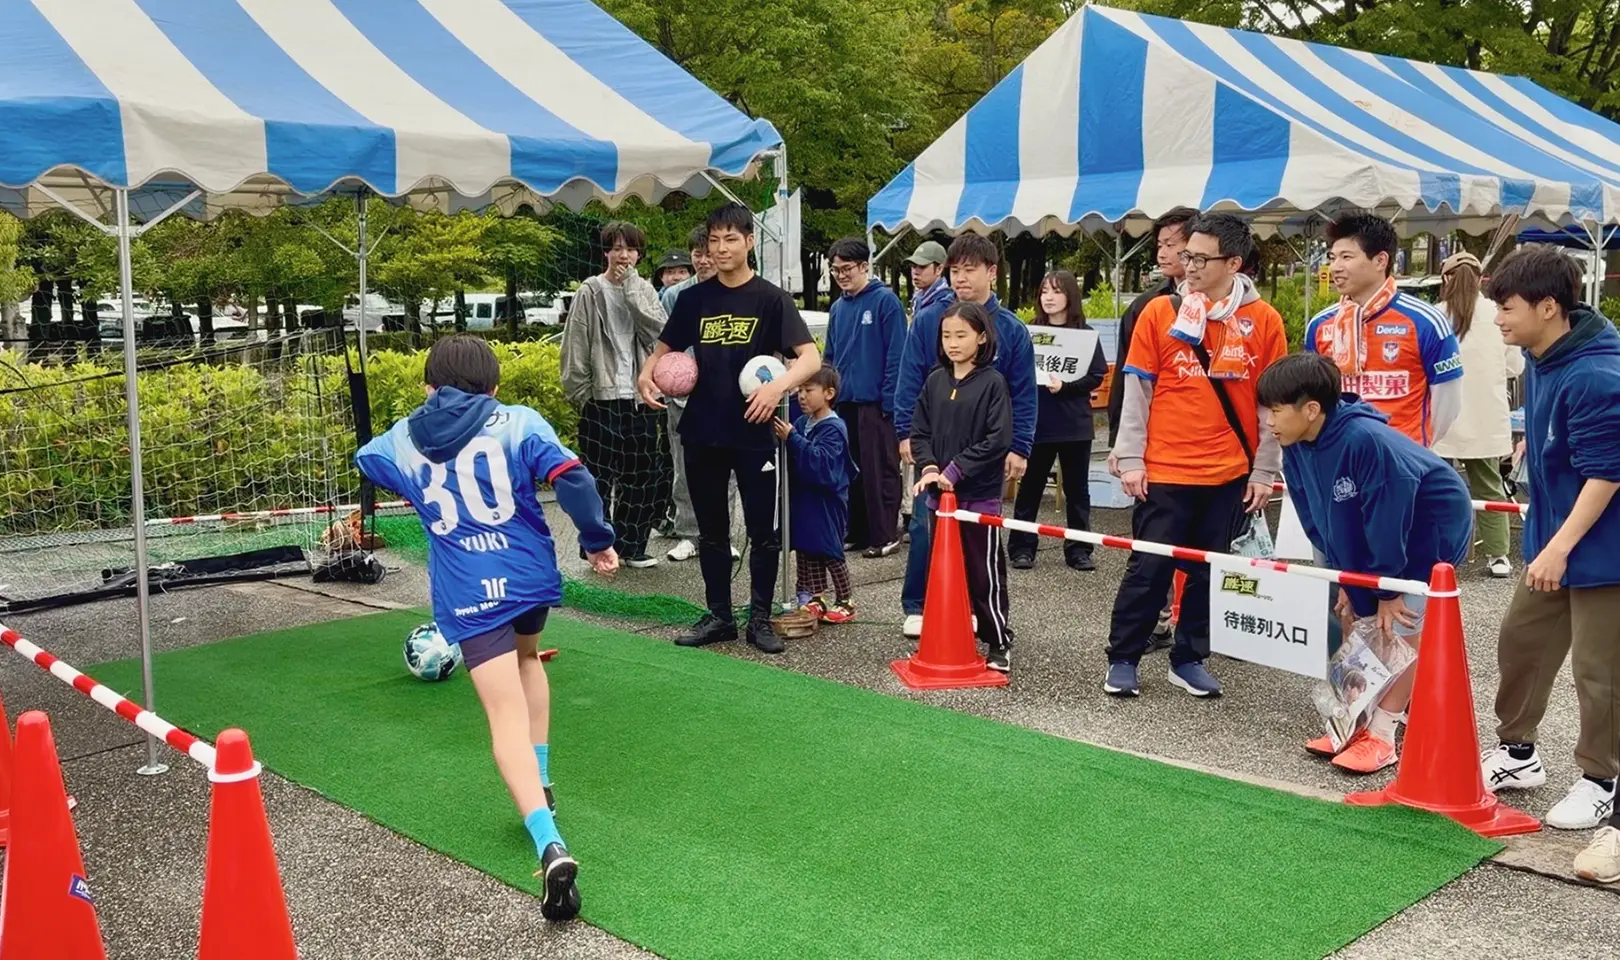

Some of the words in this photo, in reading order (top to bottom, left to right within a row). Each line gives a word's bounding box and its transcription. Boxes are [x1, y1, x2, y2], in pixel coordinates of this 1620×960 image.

[1375, 324, 1406, 335] Denka
[416, 436, 516, 535] 30
[459, 532, 509, 552] YUKI
[1224, 610, 1308, 646] 待機列入口
